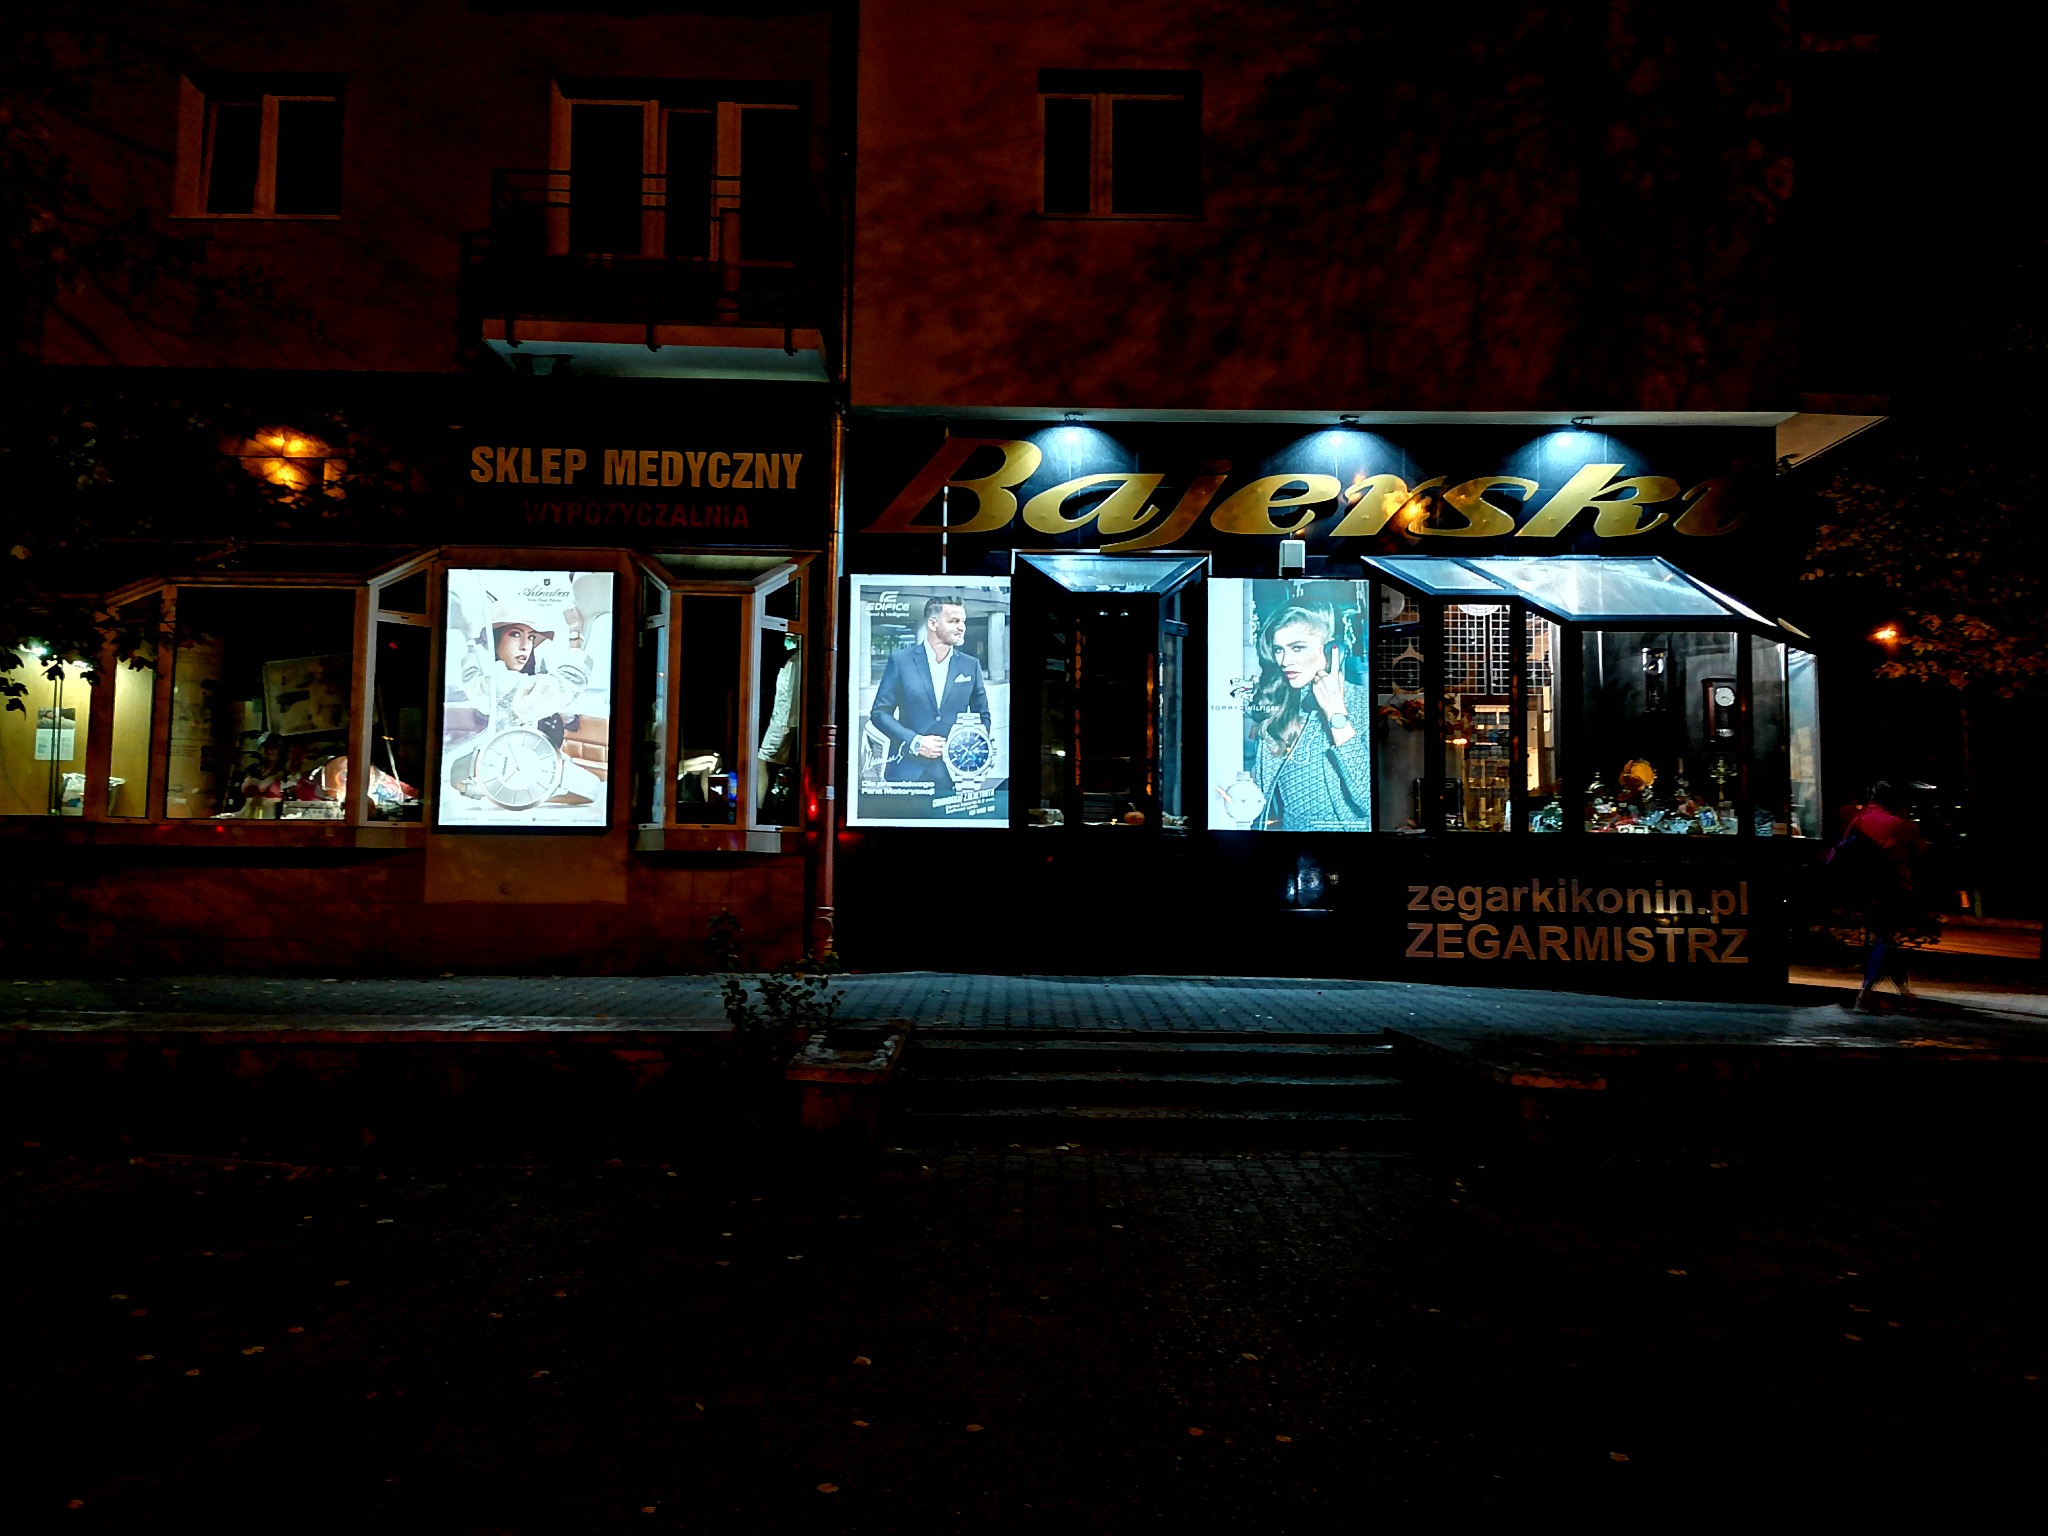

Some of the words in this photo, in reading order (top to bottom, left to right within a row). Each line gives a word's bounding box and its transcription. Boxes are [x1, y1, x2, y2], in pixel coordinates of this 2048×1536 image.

[470, 446, 588, 486] SKLEP
[603, 450, 804, 490] MEDYCZNY
[861, 436, 1752, 554] Bajerski
[1406, 878, 1749, 924] zegarkikonin.pl
[1404, 921, 1750, 964] ZEGARMISTRZ
